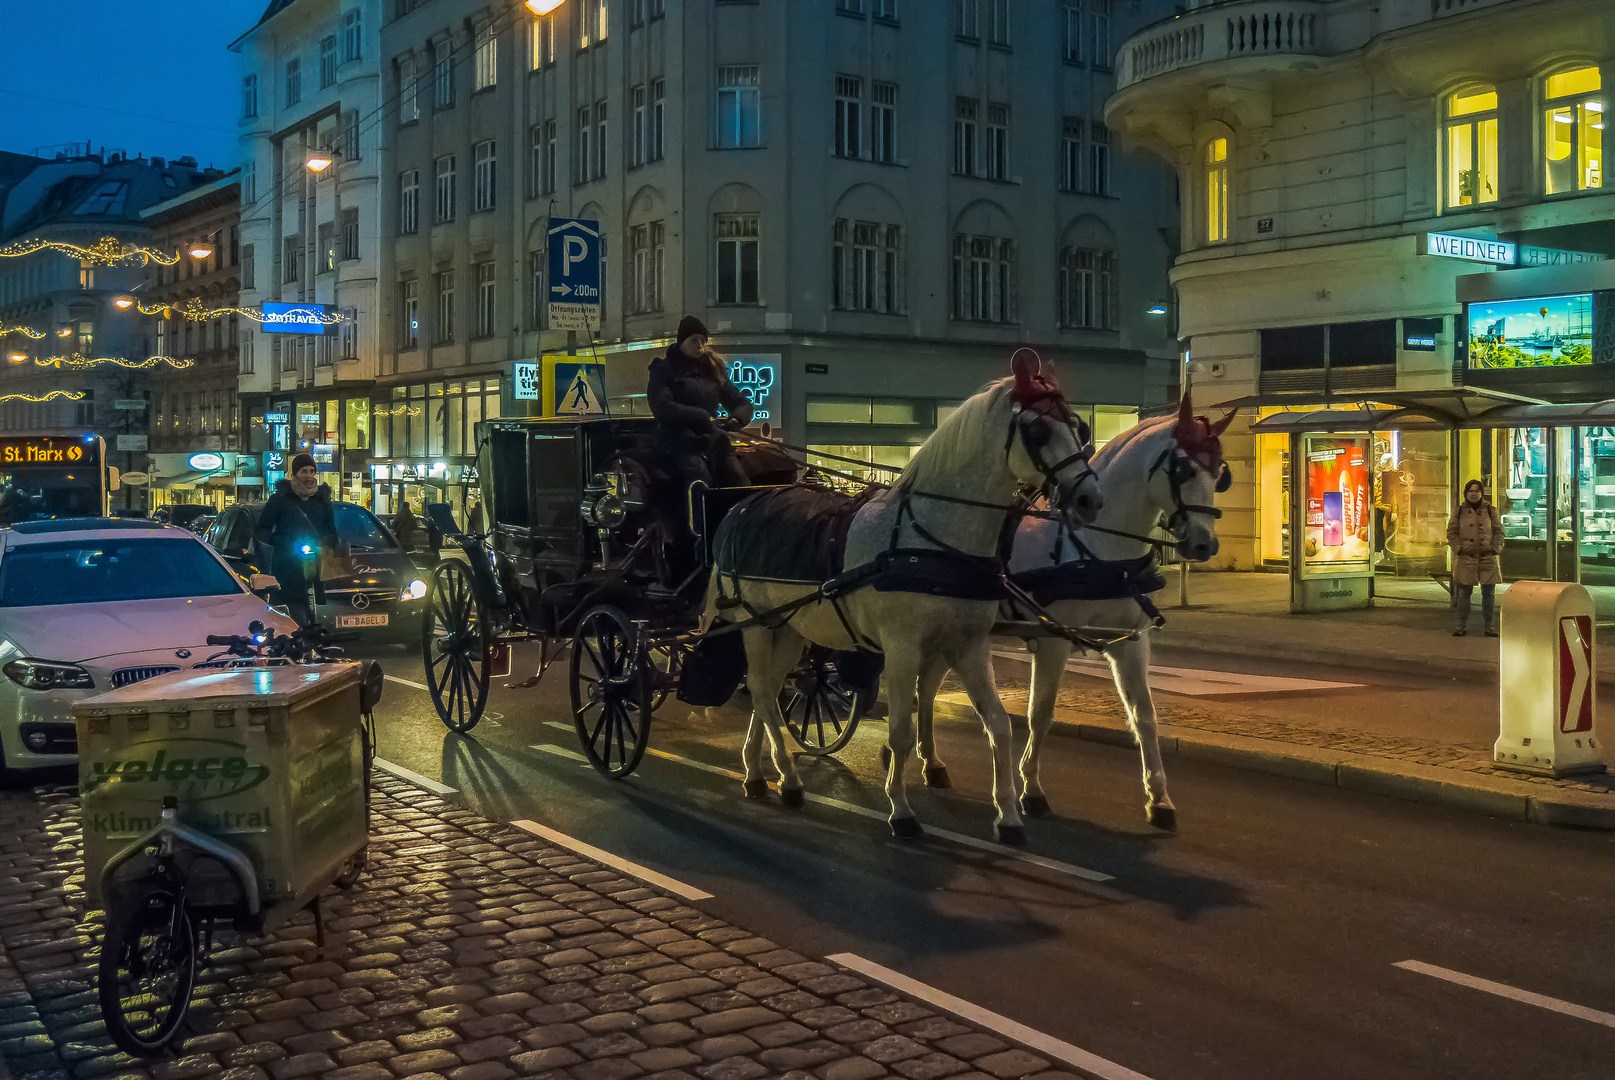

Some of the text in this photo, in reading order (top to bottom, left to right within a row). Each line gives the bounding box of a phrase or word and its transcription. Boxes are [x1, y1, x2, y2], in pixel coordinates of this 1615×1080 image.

[1260, 220, 1271, 228] 27
[563, 235, 588, 277] P
[1435, 236, 1506, 261] WEIDNER
[574, 284, 598, 297] 200m
[729, 360, 774, 389] ing
[5, 446, 64, 462] St. Marx
[1342, 482, 1353, 531] DOPPELTE
[355, 616, 380, 626] BAGEL
[381, 615, 387, 624] 3
[93, 749, 249, 784] veloce
